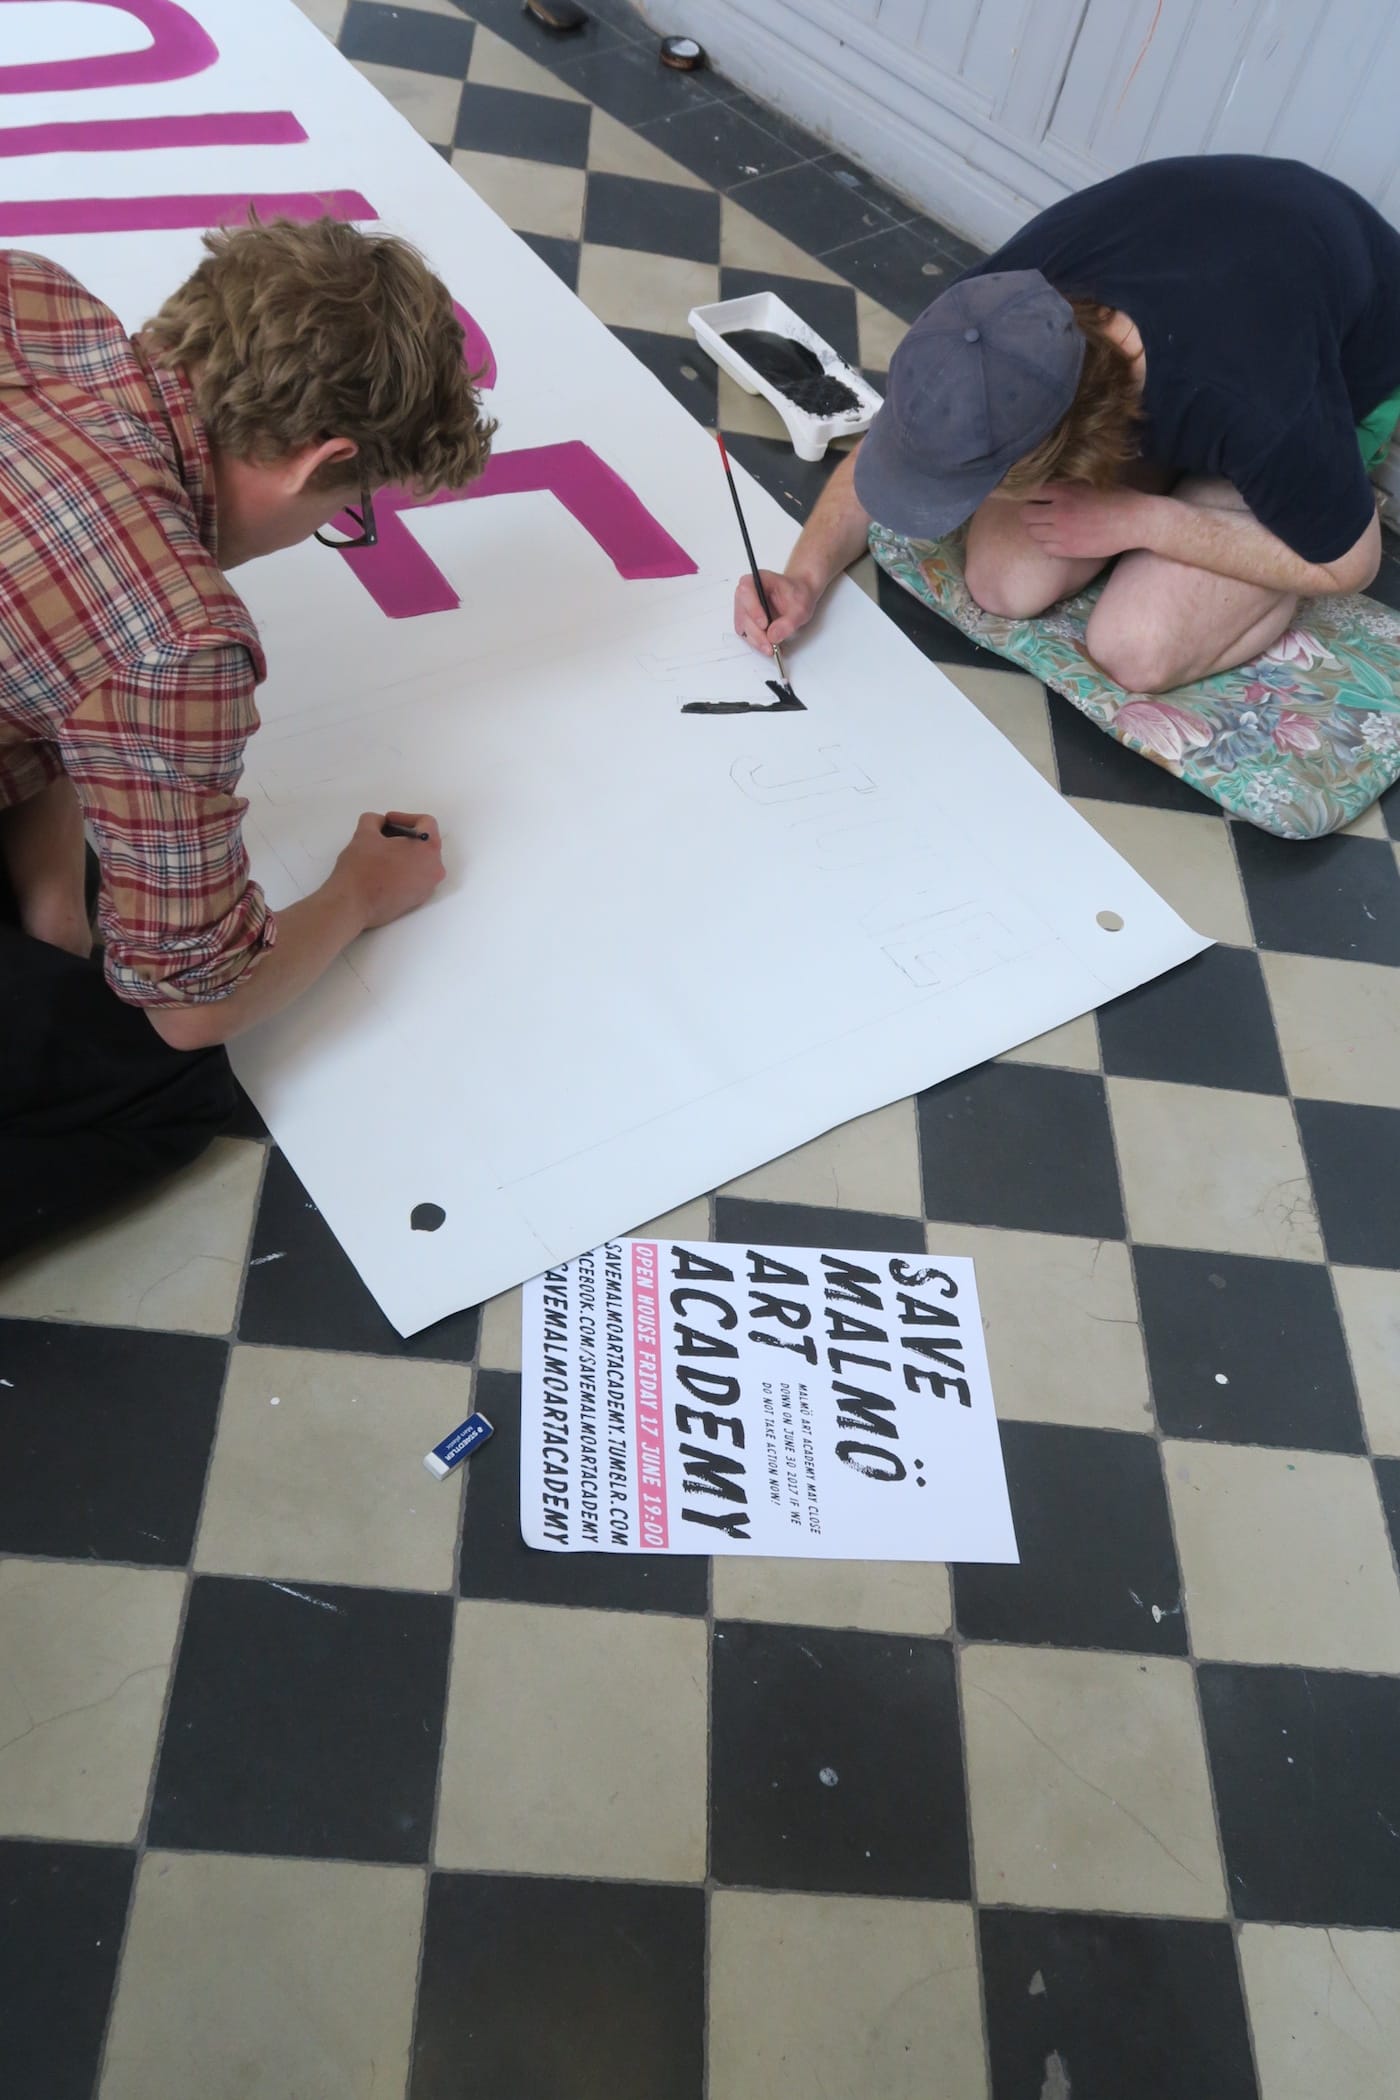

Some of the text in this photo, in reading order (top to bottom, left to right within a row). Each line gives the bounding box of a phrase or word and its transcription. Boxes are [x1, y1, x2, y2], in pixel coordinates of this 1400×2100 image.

[579, 1250, 598, 1542] ACEBOOK.COM/SAVEMALMOARTACADEMY
[605, 1243, 626, 1545] SAVEMALMOARTACADEMY.TUMBLR.COM
[636, 1246, 662, 1548] OPEN HOUSE FRIDAY 17 JUNE 19:00
[670, 1245, 751, 1539] ACADEMY
[746, 1249, 817, 1365] ART
[820, 1254, 925, 1487] MALMÖ
[889, 1258, 971, 1407] SAVE
[762, 1382, 781, 1506] DO NOT TAKE ACTION NOW!
[781, 1383, 802, 1526] DOWN ON JUNE 30 2017 IF WE
[799, 1384, 821, 1535] MALMÖ ART ACADEMY MAY CLOSE
